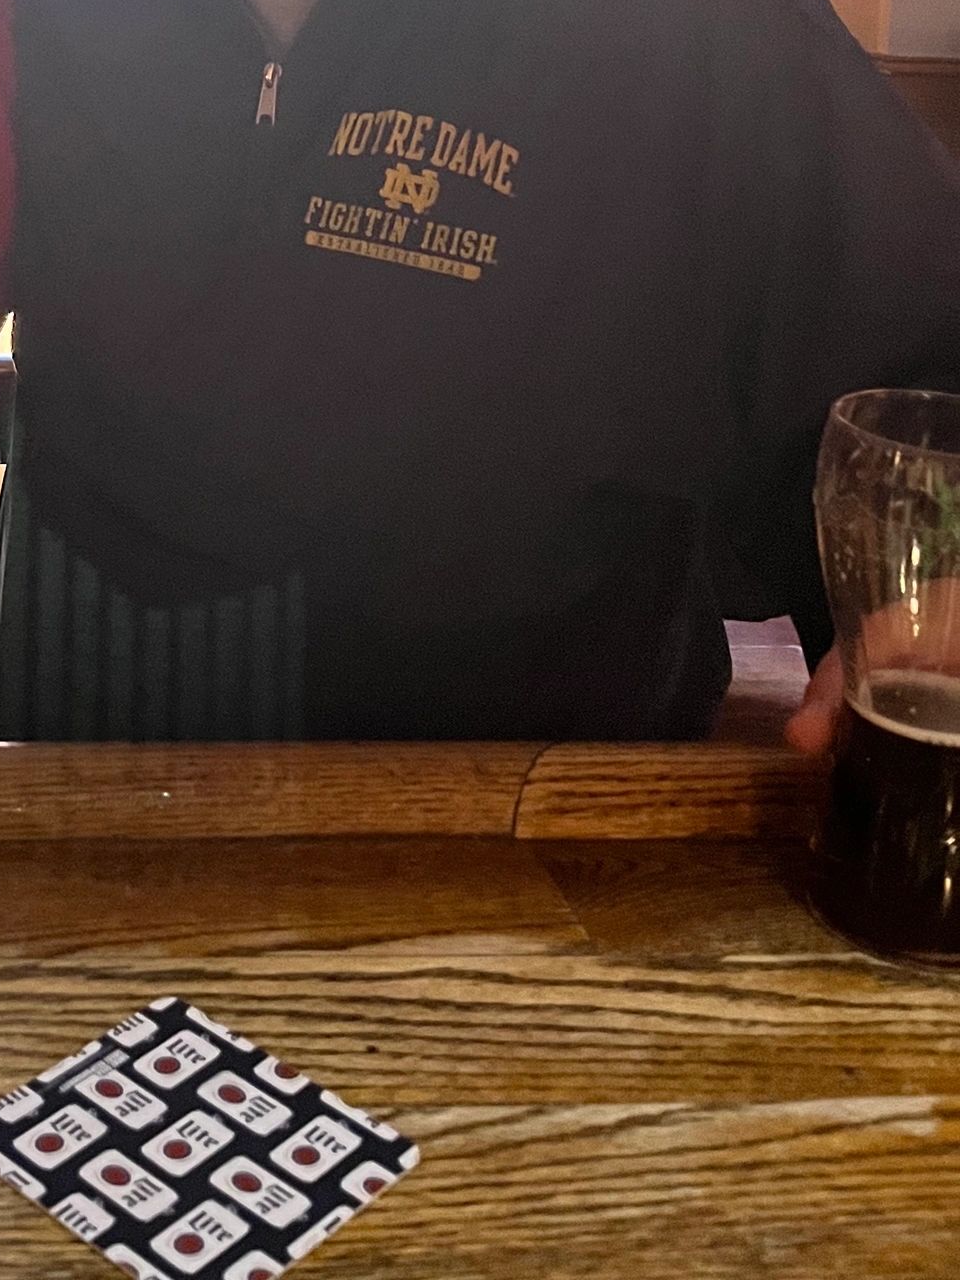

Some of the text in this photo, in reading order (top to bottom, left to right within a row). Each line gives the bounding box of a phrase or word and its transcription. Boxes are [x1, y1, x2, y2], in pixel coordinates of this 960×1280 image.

[328, 109, 520, 196] NOTRE DAME
[421, 222, 497, 264] IRISH
[166, 1038, 206, 1064] Lite
[115, 1089, 153, 1117] Lite
[240, 1095, 277, 1123] Lite
[50, 1113, 92, 1141] Lite
[176, 1120, 219, 1148] Lite
[304, 1125, 347, 1153] Lite
[121, 1176, 163, 1207] Lite
[255, 1183, 294, 1214] Lite
[188, 1210, 233, 1242] Lite
